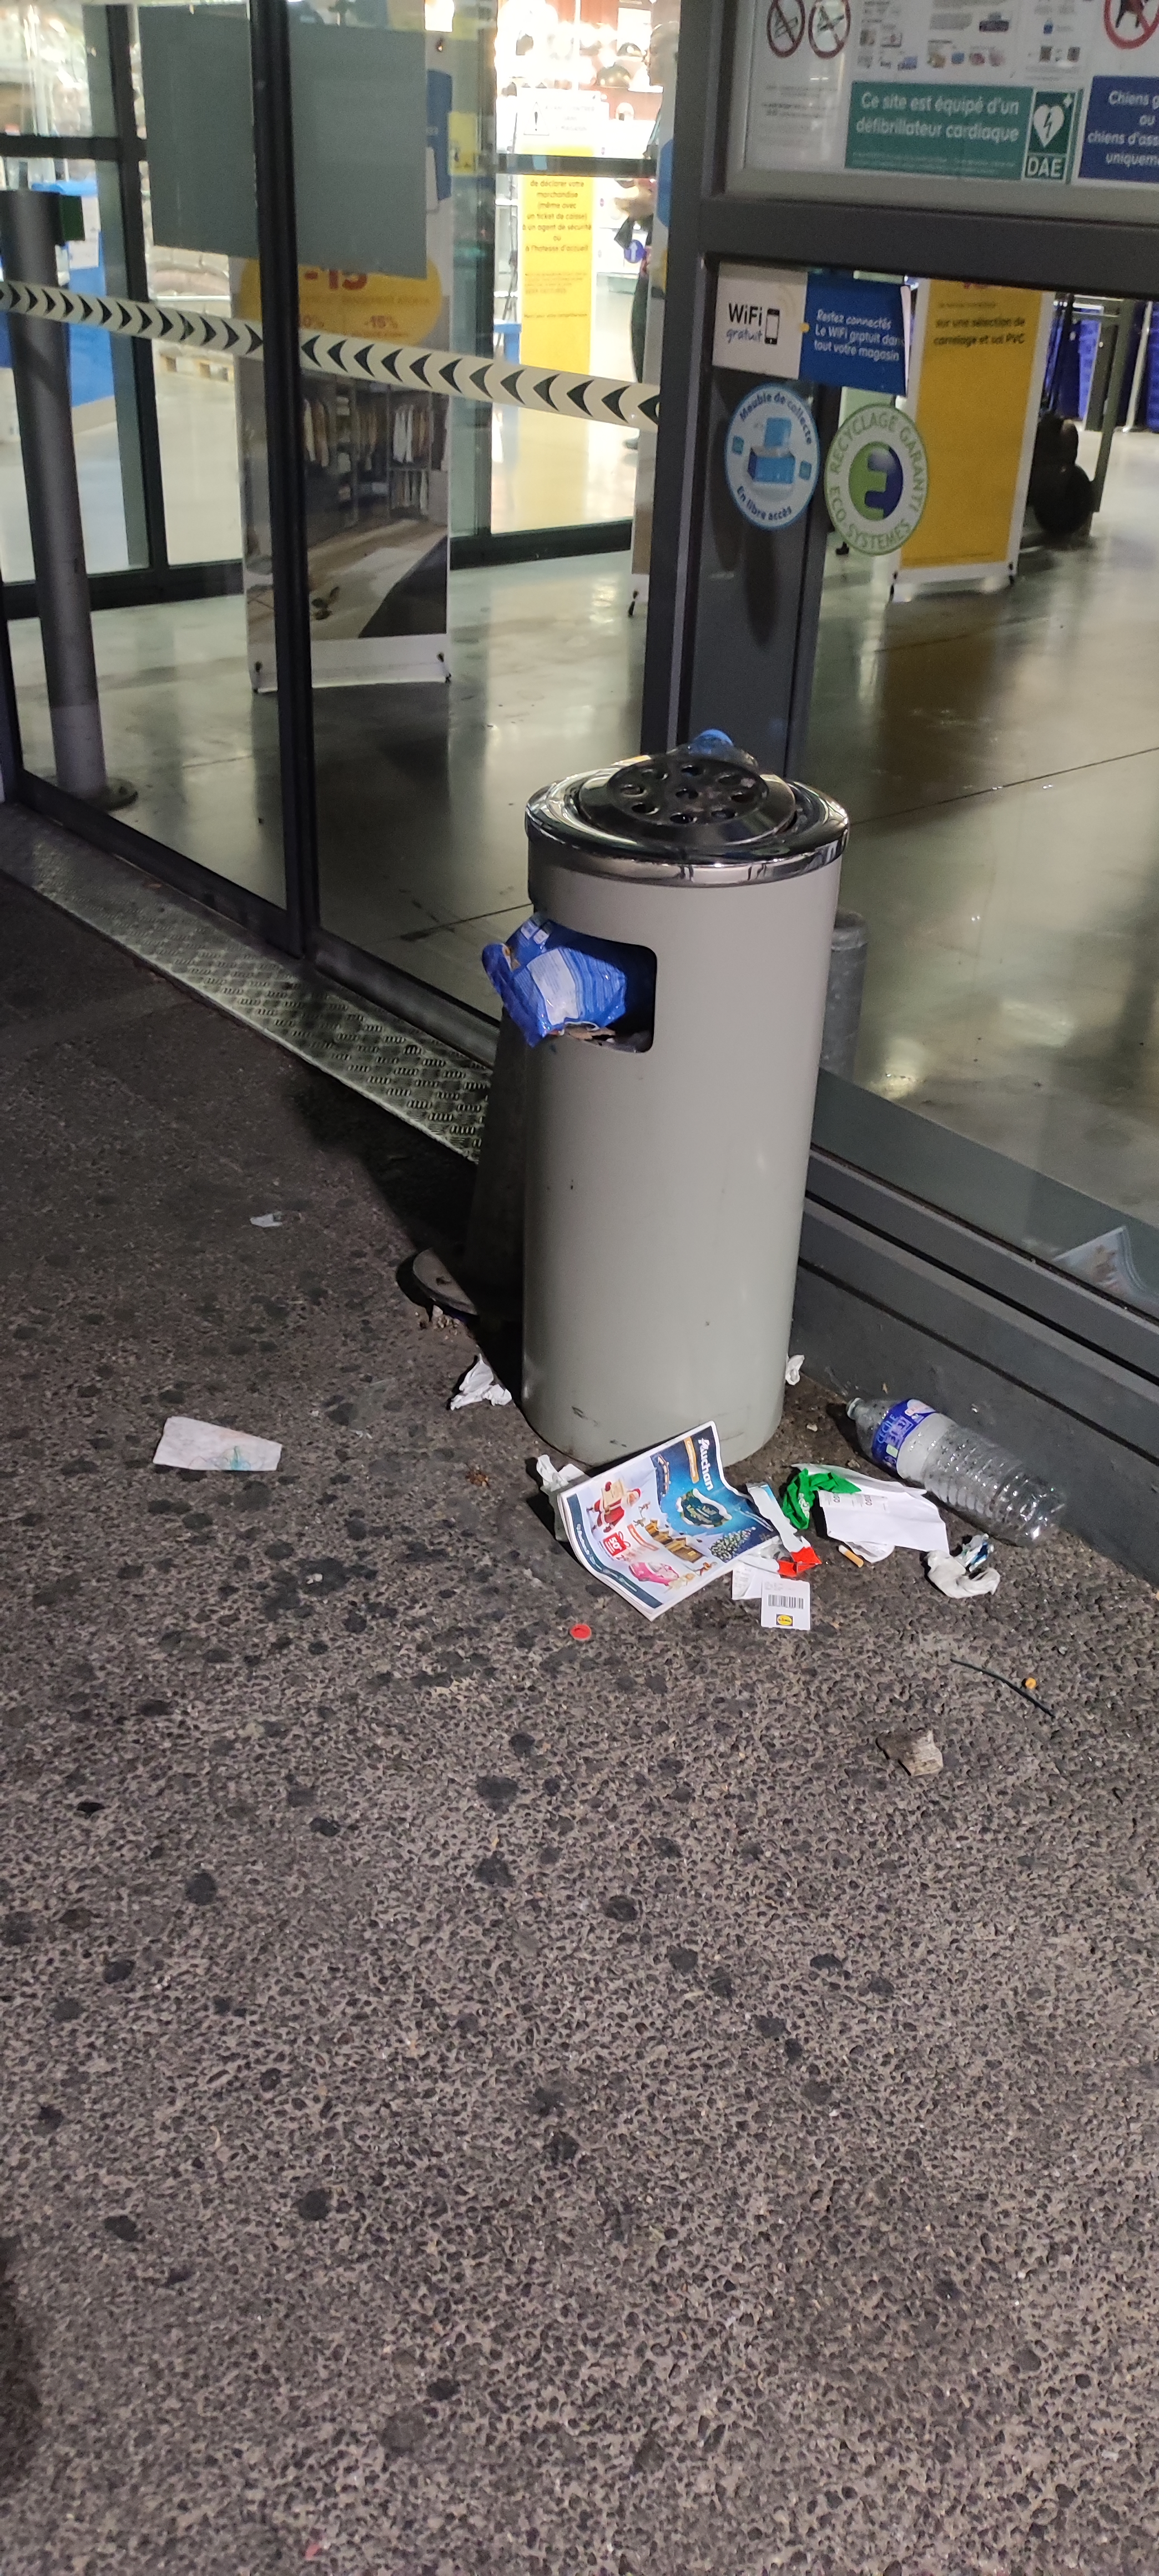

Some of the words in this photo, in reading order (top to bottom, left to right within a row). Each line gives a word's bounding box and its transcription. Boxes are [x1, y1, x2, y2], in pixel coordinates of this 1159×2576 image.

[861, 92, 879, 109] Ce
[883, 93, 907, 110] site
[910, 95, 932, 111] est
[935, 95, 984, 117] équipé
[987, 96, 1020, 115] d'un
[1108, 90, 1150, 106] Chiens
[856, 116, 942, 137] défibrillateur
[946, 123, 1020, 143] cardiaque
[1140, 114, 1156, 126] ou
[1087, 130, 1125, 144] chiens
[1128, 132, 1159, 147] d'ass
[1027, 158, 1062, 178] DAE
[1106, 153, 1159, 168] uniquem
[728, 302, 763, 326] WiFi
[817, 309, 844, 323] Restez
[846, 316, 891, 330] connectés
[726, 329, 763, 344] gratuit
[815, 324, 827, 337] Le
[828, 326, 848, 339] WiFi
[849, 331, 880, 345] gratuit
[1005, 333, 1025, 344] PVC
[814, 339, 832, 351] tout
[834, 343, 857, 355] votre
[858, 348, 900, 361] magasin
[739, 392, 772, 422] Meuble
[774, 392, 785, 405] de
[787, 401, 812, 445] collecte
[830, 412, 898, 475] RECYCLAGE
[899, 426, 925, 512] GARANTI
[737, 486, 746, 502] En
[746, 499, 767, 520] libre
[768, 506, 792, 521] accès
[697, 1437, 714, 1491] Auchan
